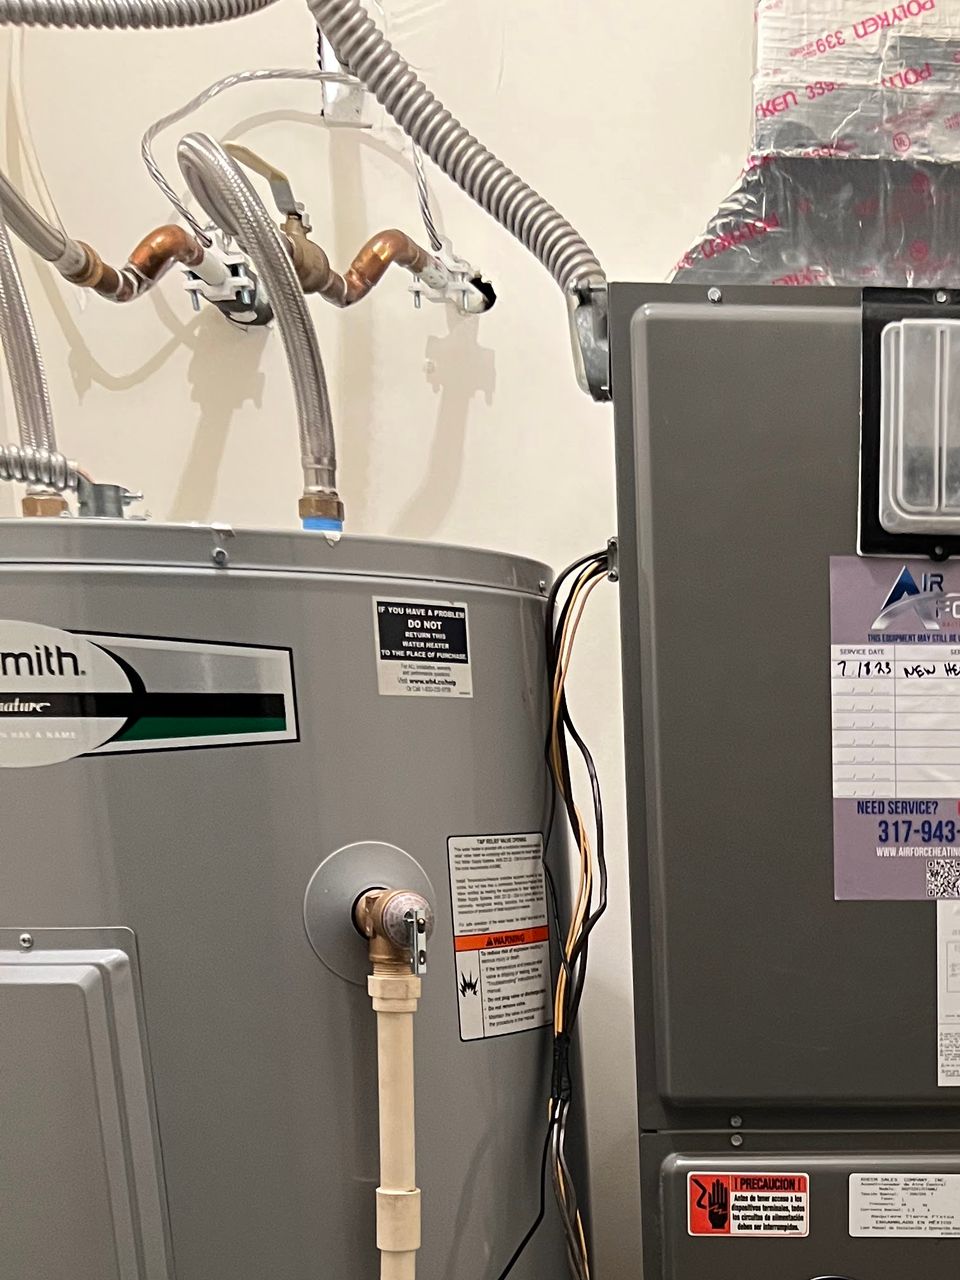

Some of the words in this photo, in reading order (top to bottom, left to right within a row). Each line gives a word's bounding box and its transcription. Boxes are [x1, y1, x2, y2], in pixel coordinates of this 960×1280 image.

[816, 31, 845, 54] 339
[406, 608, 426, 616] HAVE
[434, 610, 465, 619] PROBLEM
[408, 619, 421, 628] DO
[424, 621, 442, 630] NOT
[405, 631, 431, 639] RETURN
[868, 634, 882, 642] THIS
[882, 634, 916, 642] EQUIPMENT
[918, 634, 930, 642] MAY
[932, 634, 947, 642] STILL
[904, 664, 936, 678] NEW
[857, 801, 884, 815] NEED
[888, 801, 938, 815] SERVICE?
[493, 934, 525, 945] WARNING
[740, 1179, 795, 1190] PRECAUCION
[731, 1204, 761, 1212] dispositivos
